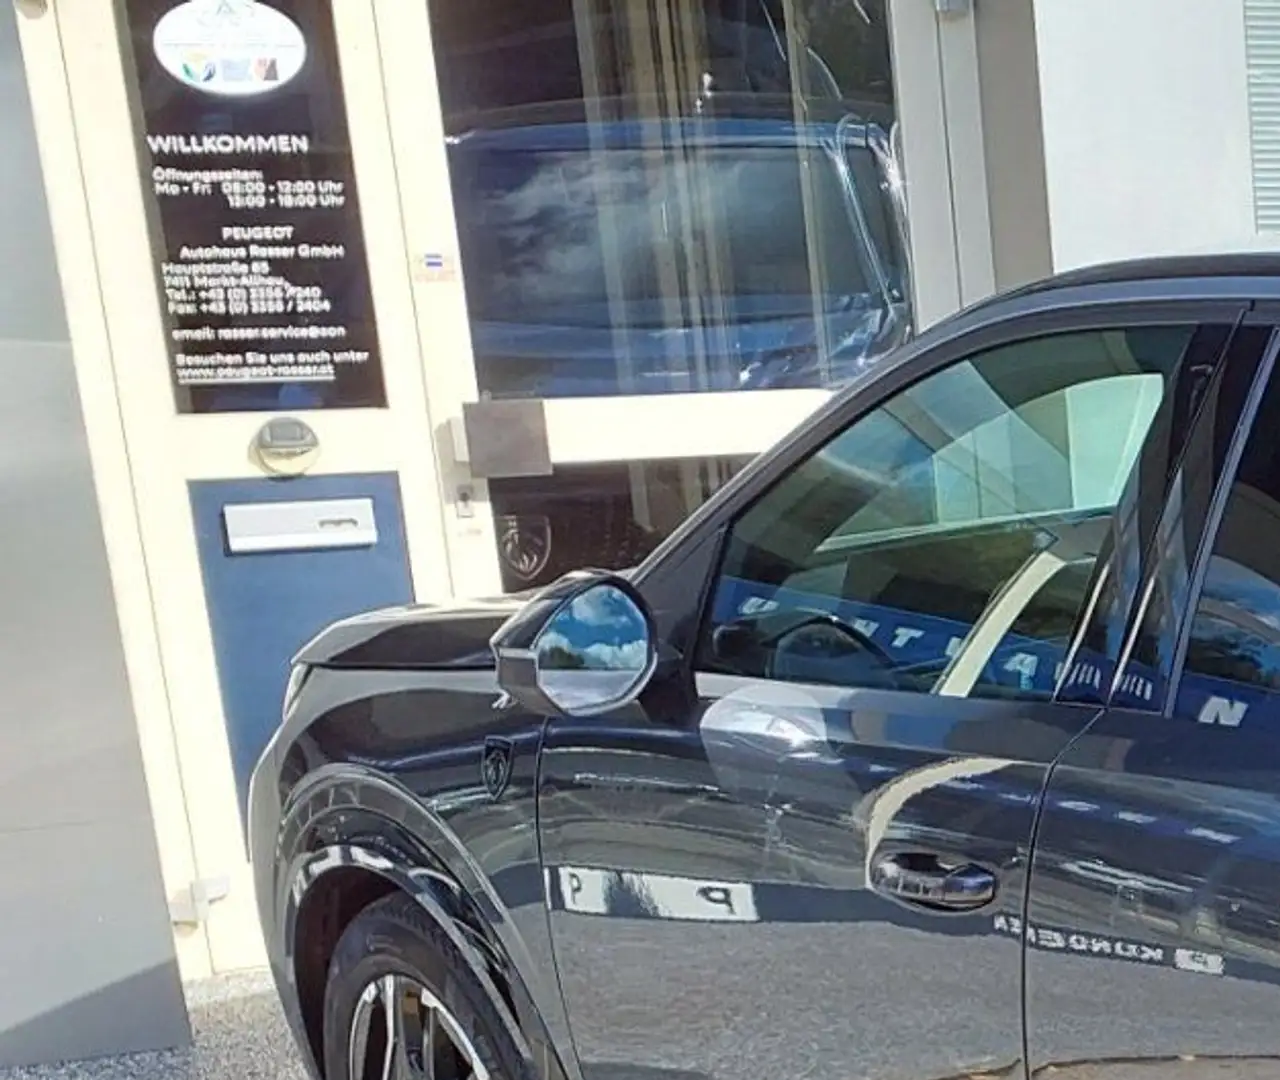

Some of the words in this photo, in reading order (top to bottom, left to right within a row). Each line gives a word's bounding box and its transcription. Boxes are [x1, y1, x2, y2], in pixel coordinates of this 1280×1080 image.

[147, 134, 309, 153] WILLKOMMEN
[317, 181, 344, 193] Uhr
[319, 195, 345, 207] Uhr
[222, 226, 294, 241] PEUGEOT
[179, 245, 246, 260] Autohaus
[298, 243, 345, 258] GmbH
[175, 352, 244, 366] Besuchen
[245, 351, 268, 364] Sie
[333, 350, 369, 362] unter
